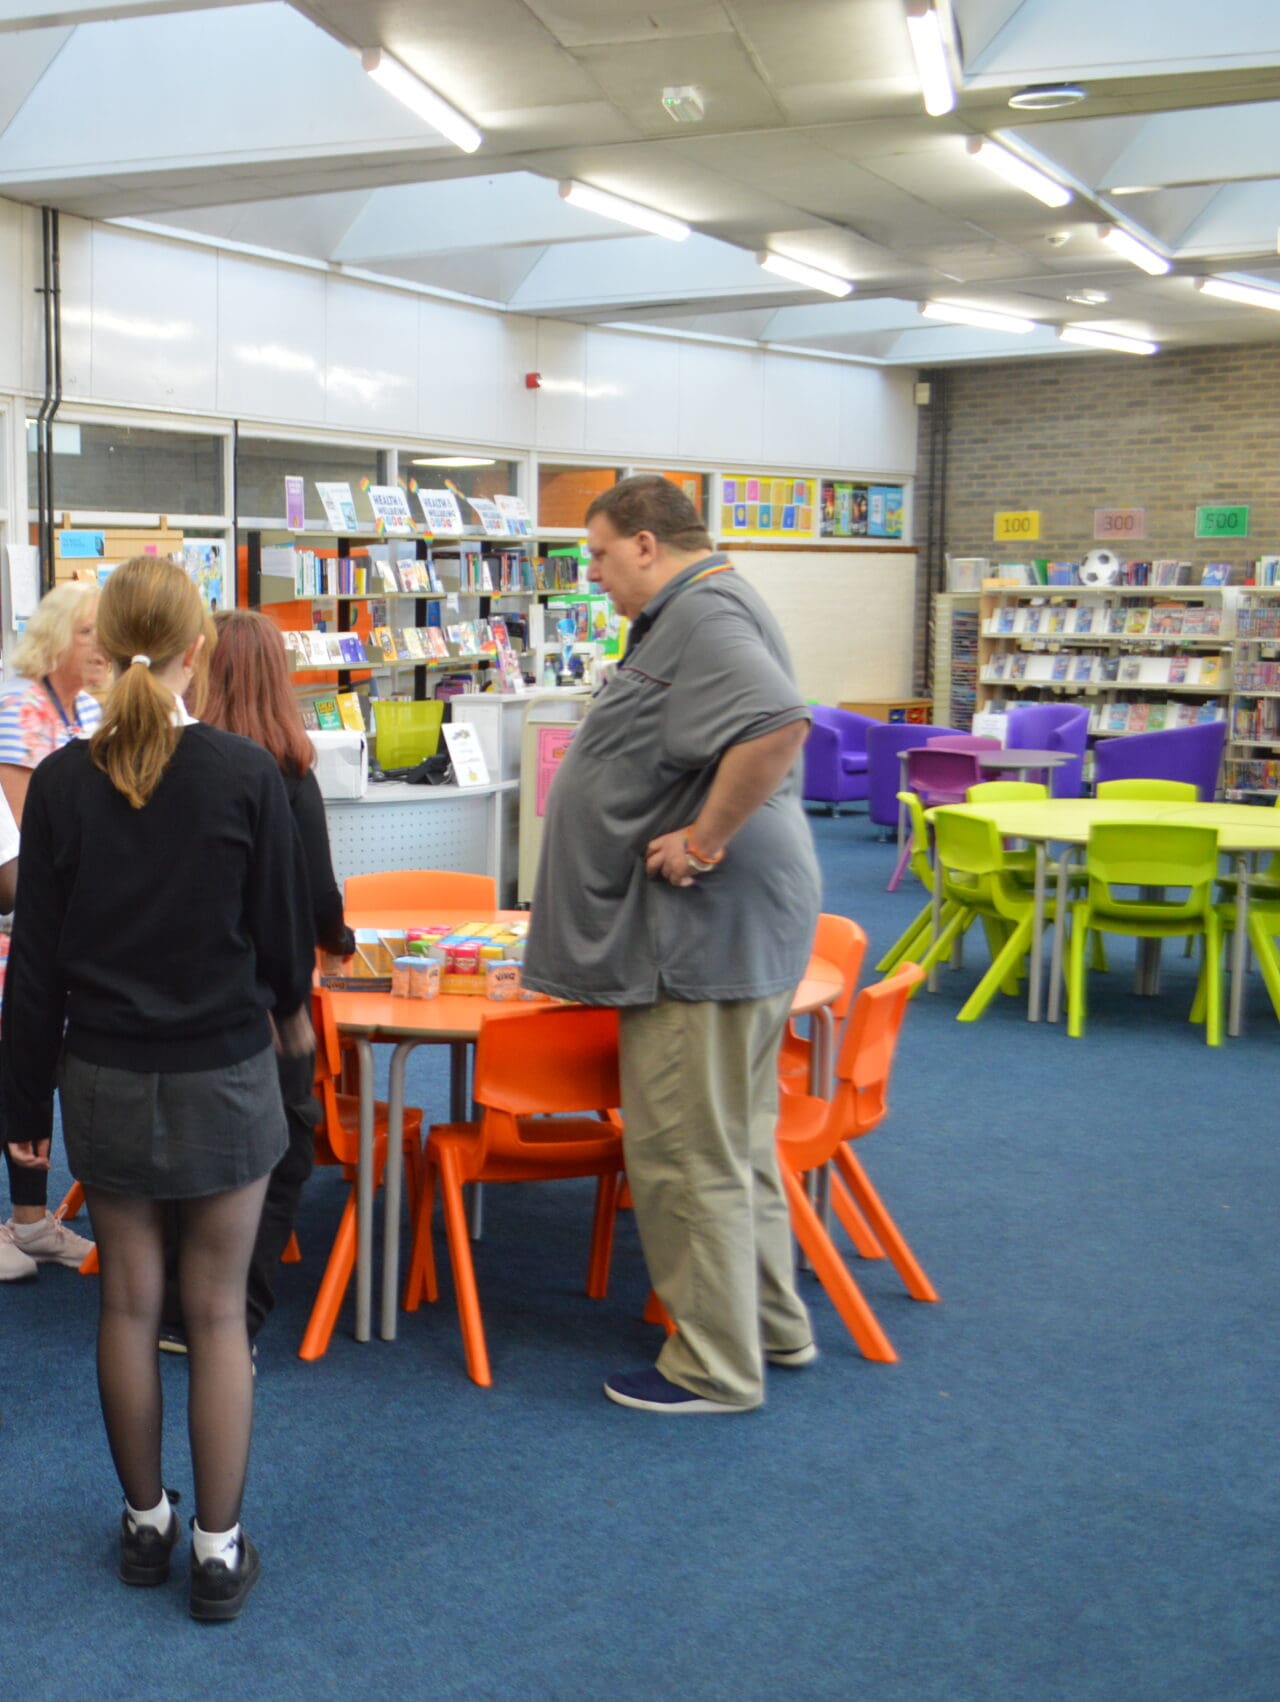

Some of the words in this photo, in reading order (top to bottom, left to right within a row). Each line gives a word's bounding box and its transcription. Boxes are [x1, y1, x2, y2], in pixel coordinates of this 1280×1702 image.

[1003, 517, 1031, 533] 100
[1103, 515, 1135, 531] 300
[1205, 512, 1238, 529] 500
